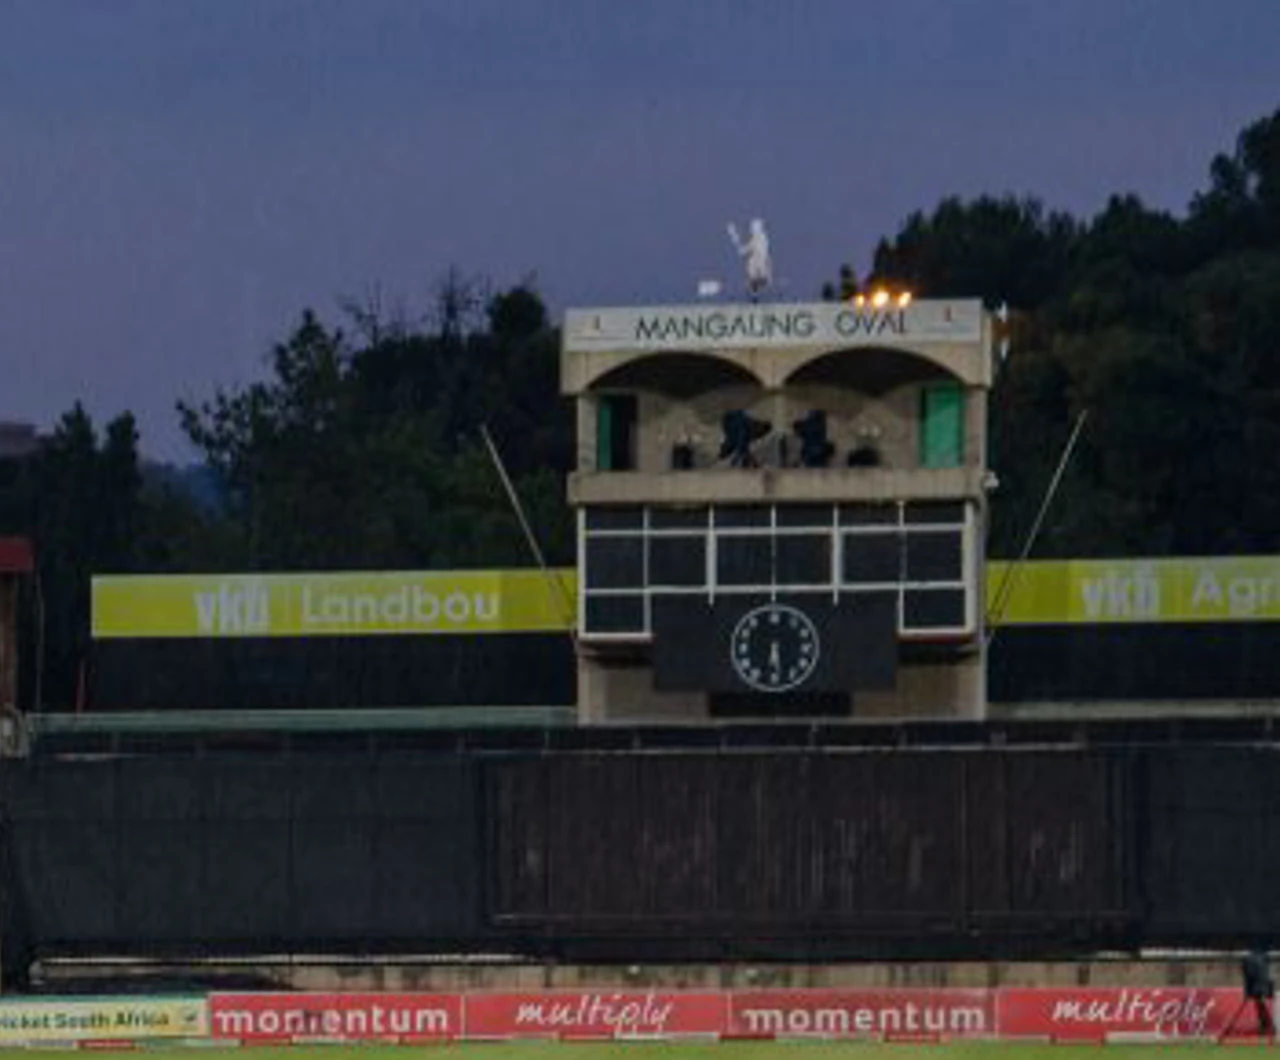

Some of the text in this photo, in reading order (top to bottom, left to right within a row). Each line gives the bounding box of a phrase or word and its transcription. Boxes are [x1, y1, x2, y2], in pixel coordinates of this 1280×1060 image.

[634, 309, 907, 340] MANGAUNG OVAL
[214, 1004, 449, 1034] momentum
[512, 992, 676, 1034] multiply
[742, 1002, 986, 1032] momentum
